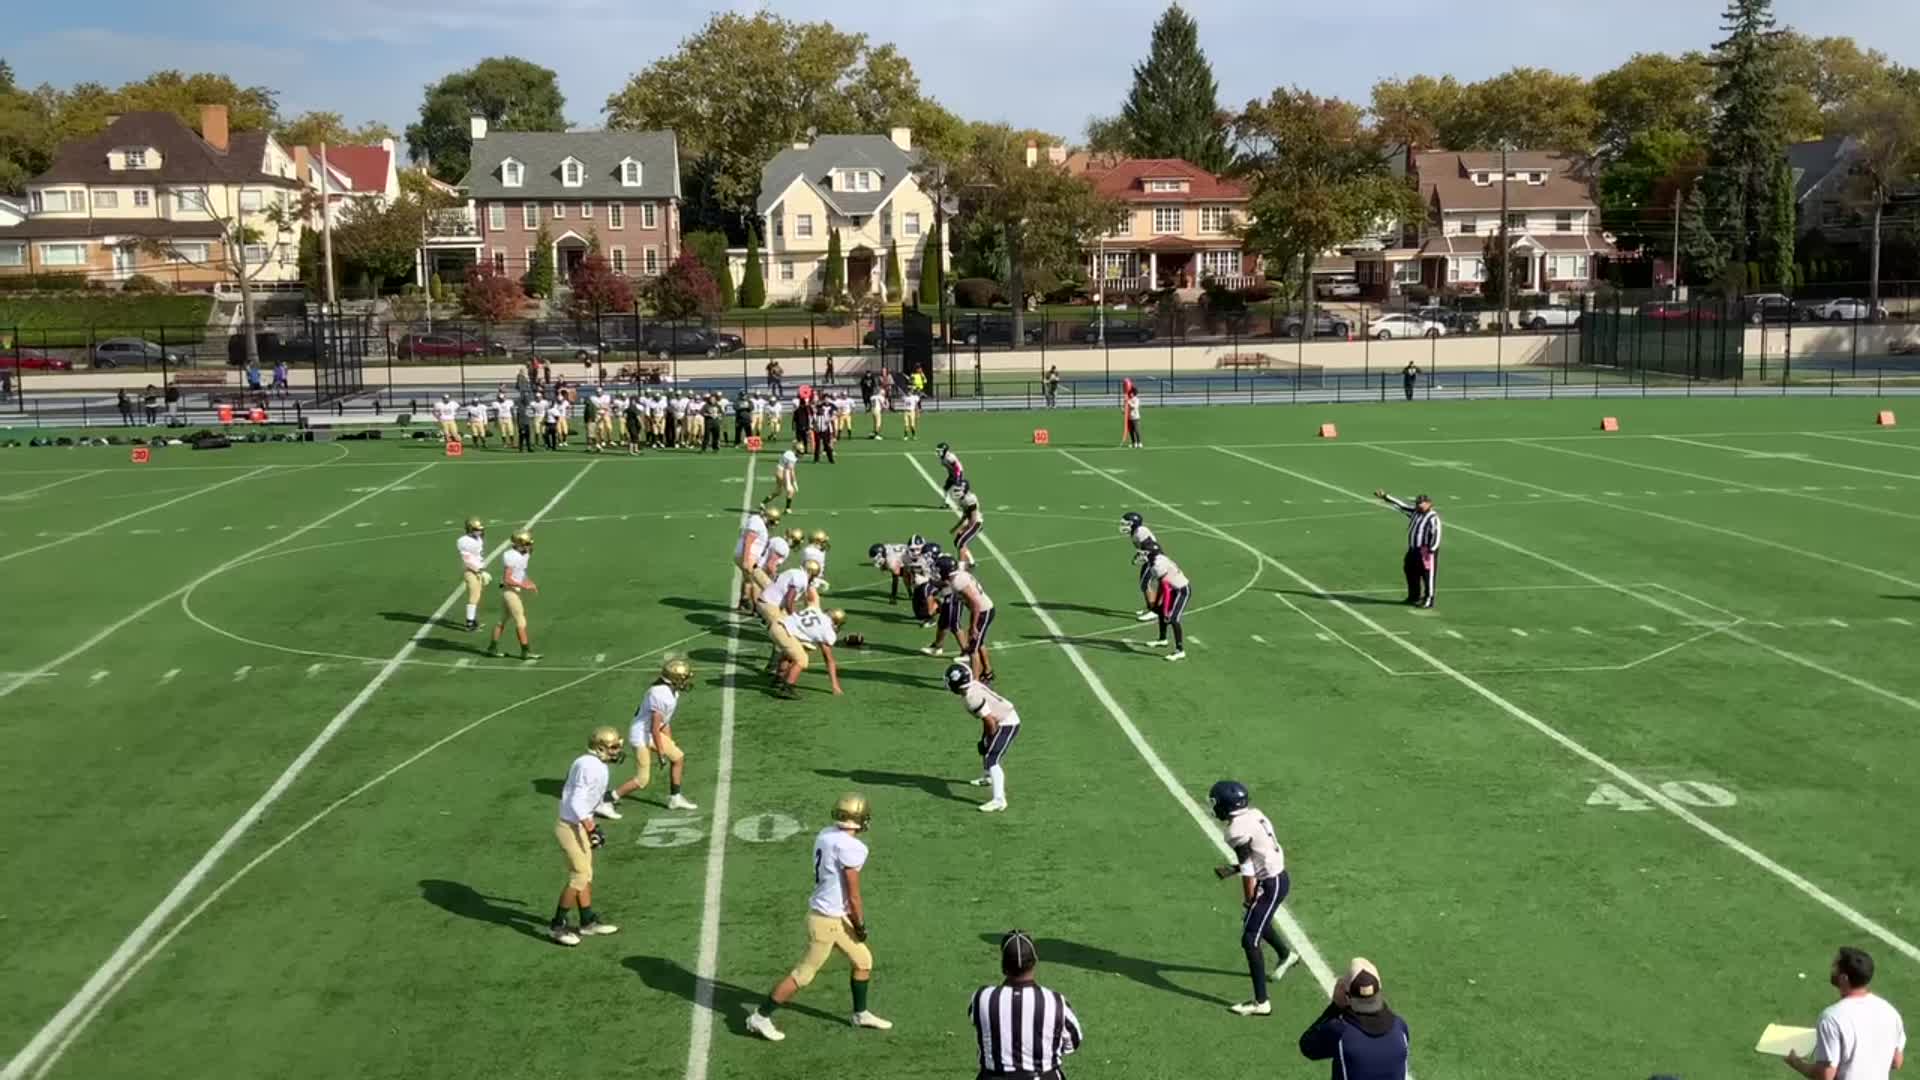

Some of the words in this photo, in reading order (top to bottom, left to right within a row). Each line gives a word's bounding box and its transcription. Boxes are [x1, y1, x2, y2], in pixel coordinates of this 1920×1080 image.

[747, 438, 761, 449] 50
[1586, 780, 1737, 811] 40
[635, 813, 802, 848] 50
